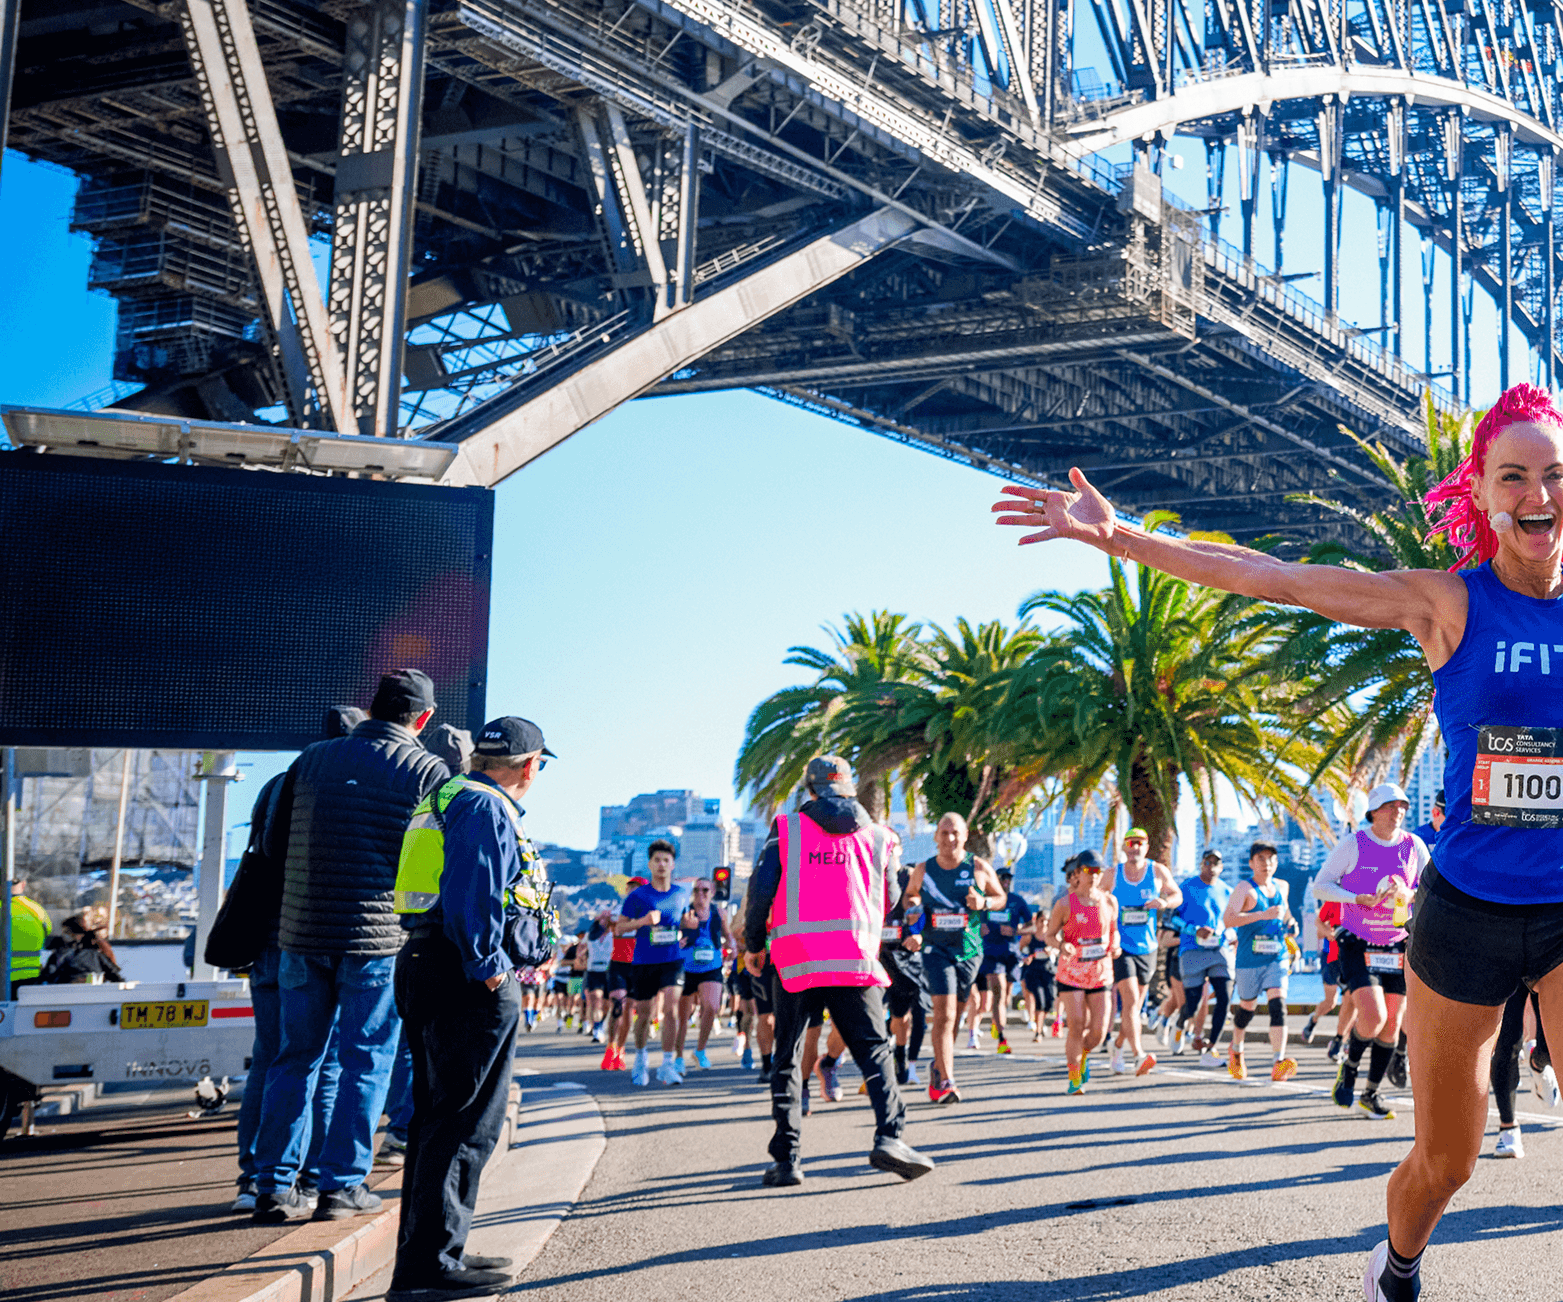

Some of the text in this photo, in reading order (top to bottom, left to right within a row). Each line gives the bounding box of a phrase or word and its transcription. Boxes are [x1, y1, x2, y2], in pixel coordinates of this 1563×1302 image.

[484, 731, 502, 739] VSR
[1488, 733, 1514, 752] tcs
[1478, 779, 1483, 790] 1
[1521, 811, 1536, 821] tcs
[126, 1004, 206, 1022] TM 78 WJ
